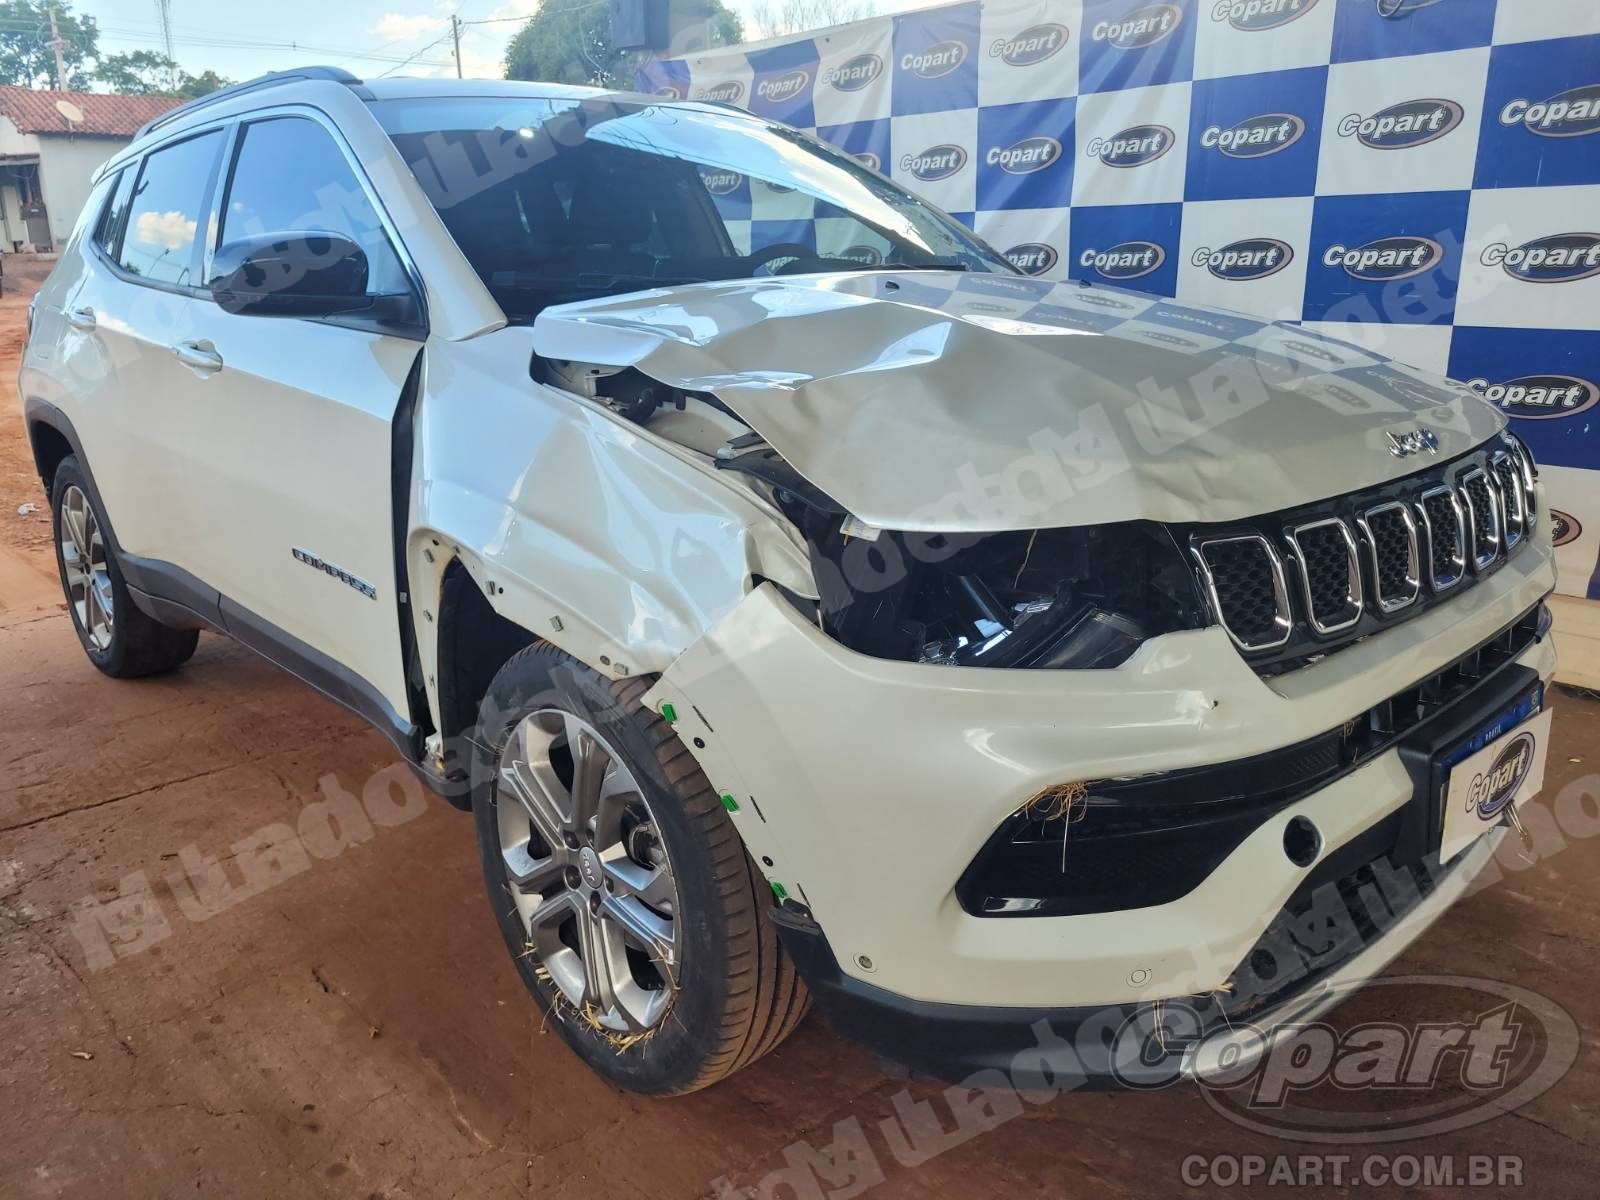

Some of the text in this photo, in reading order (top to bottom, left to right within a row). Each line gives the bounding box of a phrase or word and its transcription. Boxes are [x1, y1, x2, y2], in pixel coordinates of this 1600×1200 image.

[1092, 11, 1171, 42] Copart
[988, 29, 1058, 58] Copart
[821, 60, 875, 85] Copart
[901, 47, 960, 71] Copart
[757, 75, 802, 97] Copart
[1200, 119, 1292, 150] Copart
[1337, 105, 1446, 141] Copart
[986, 143, 1051, 166] Copart
[1087, 132, 1162, 158] Copart
[900, 149, 958, 177] Copart
[1079, 247, 1155, 270] Copart
[1191, 246, 1279, 271] Copart
[1322, 243, 1428, 271] Copart
[1480, 243, 1600, 273] Copart
[1465, 739, 1529, 813] Copart
